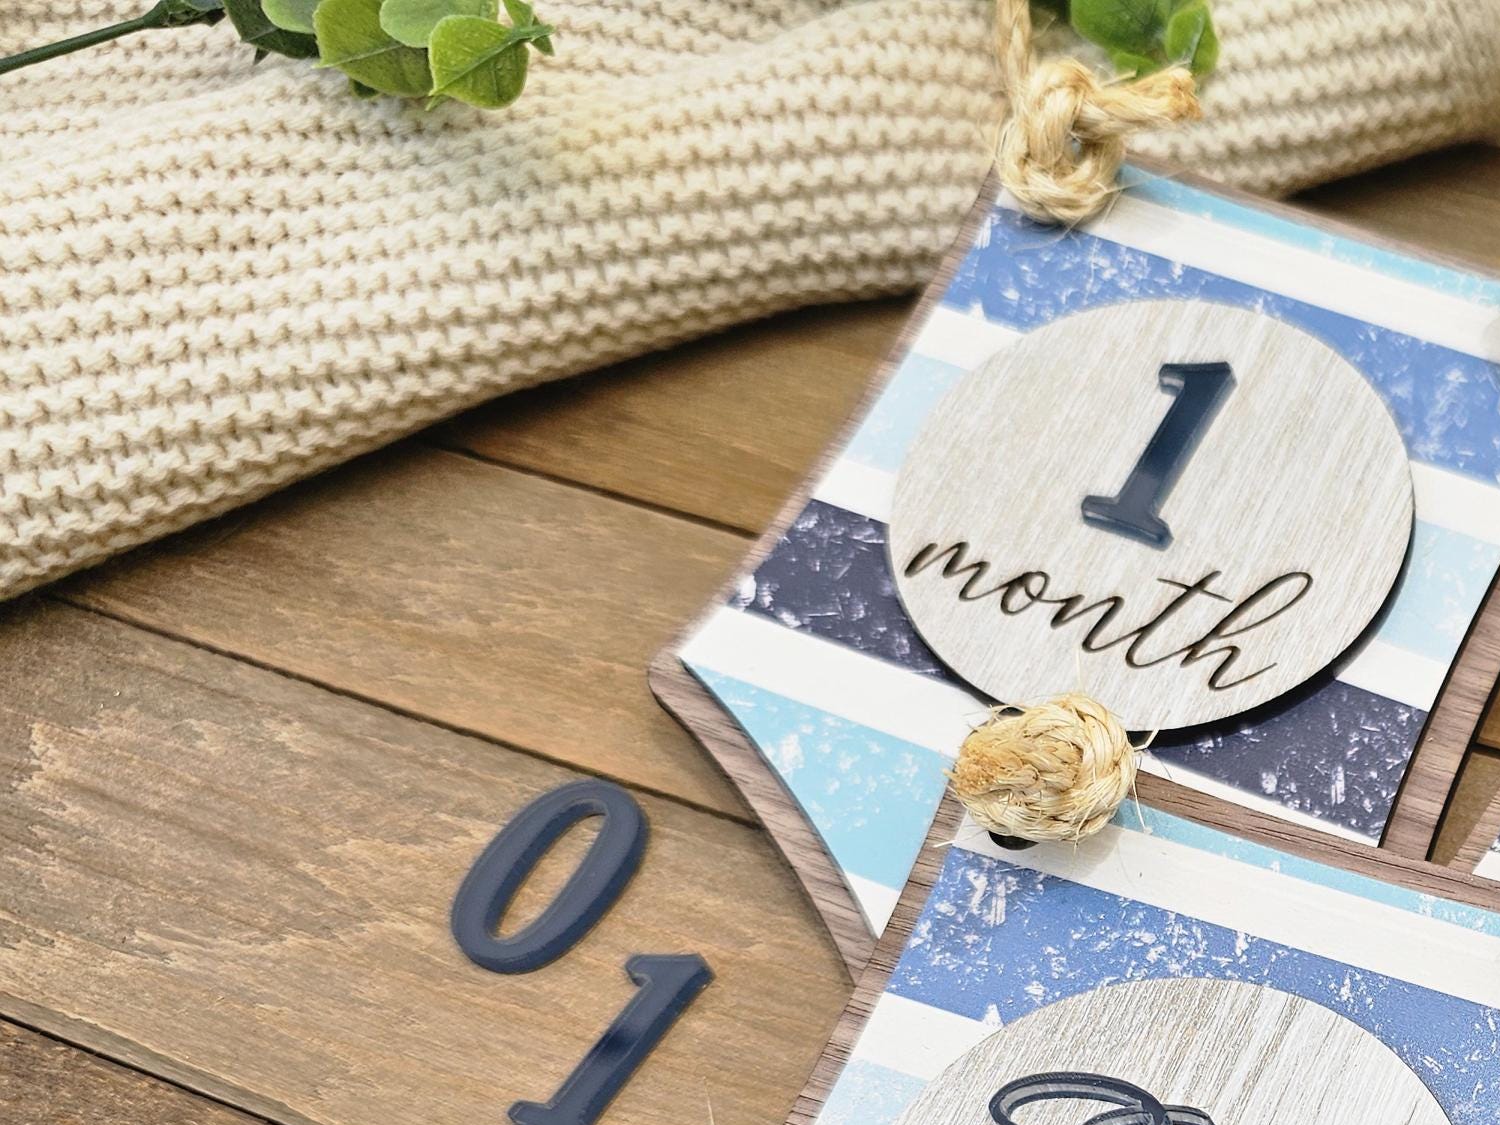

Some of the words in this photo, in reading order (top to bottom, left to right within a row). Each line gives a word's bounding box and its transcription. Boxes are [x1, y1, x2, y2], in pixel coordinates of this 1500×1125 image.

[1081, 361, 1237, 551] 1
[904, 541, 1313, 691] month
[451, 780, 648, 974] 0
